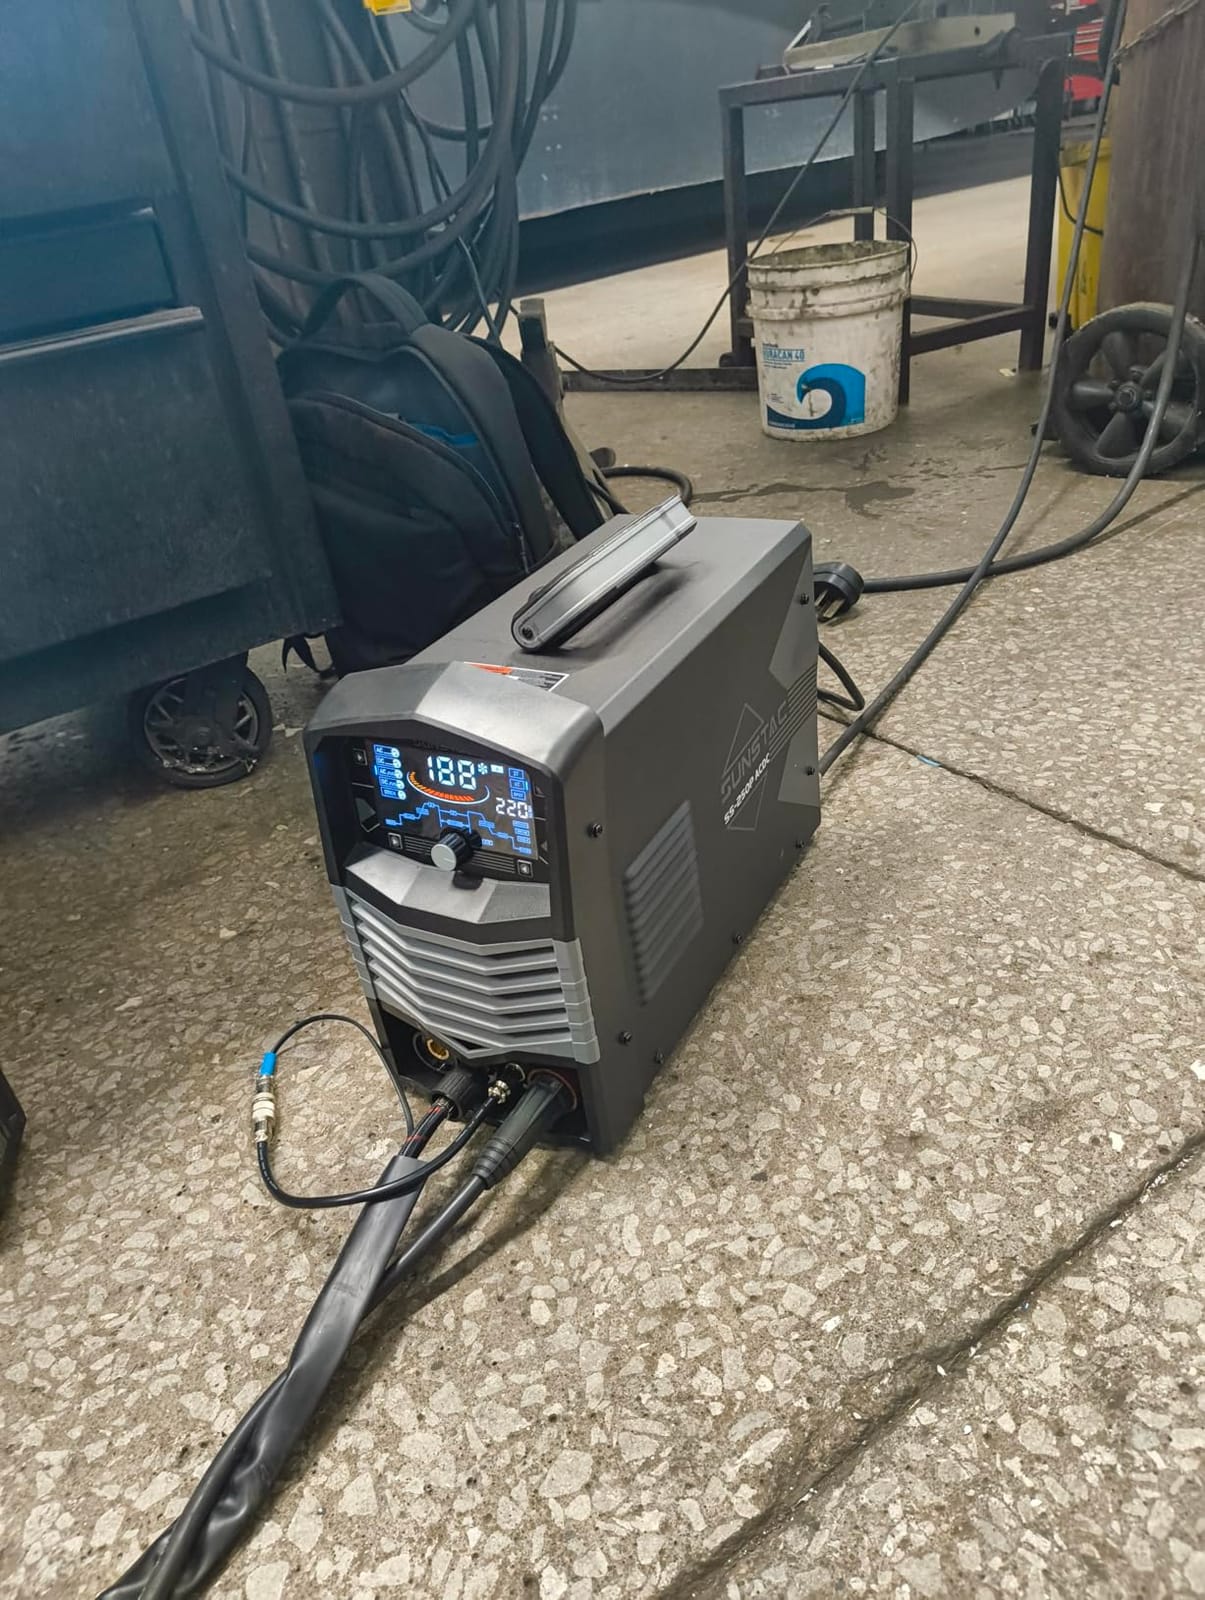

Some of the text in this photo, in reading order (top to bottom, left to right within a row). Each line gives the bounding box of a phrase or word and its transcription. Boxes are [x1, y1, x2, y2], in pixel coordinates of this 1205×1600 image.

[721, 700, 788, 804] SUNSTAC
[755, 752, 770, 781] ACDC
[427, 755, 477, 791] 188
[495, 797, 528, 819] 220
